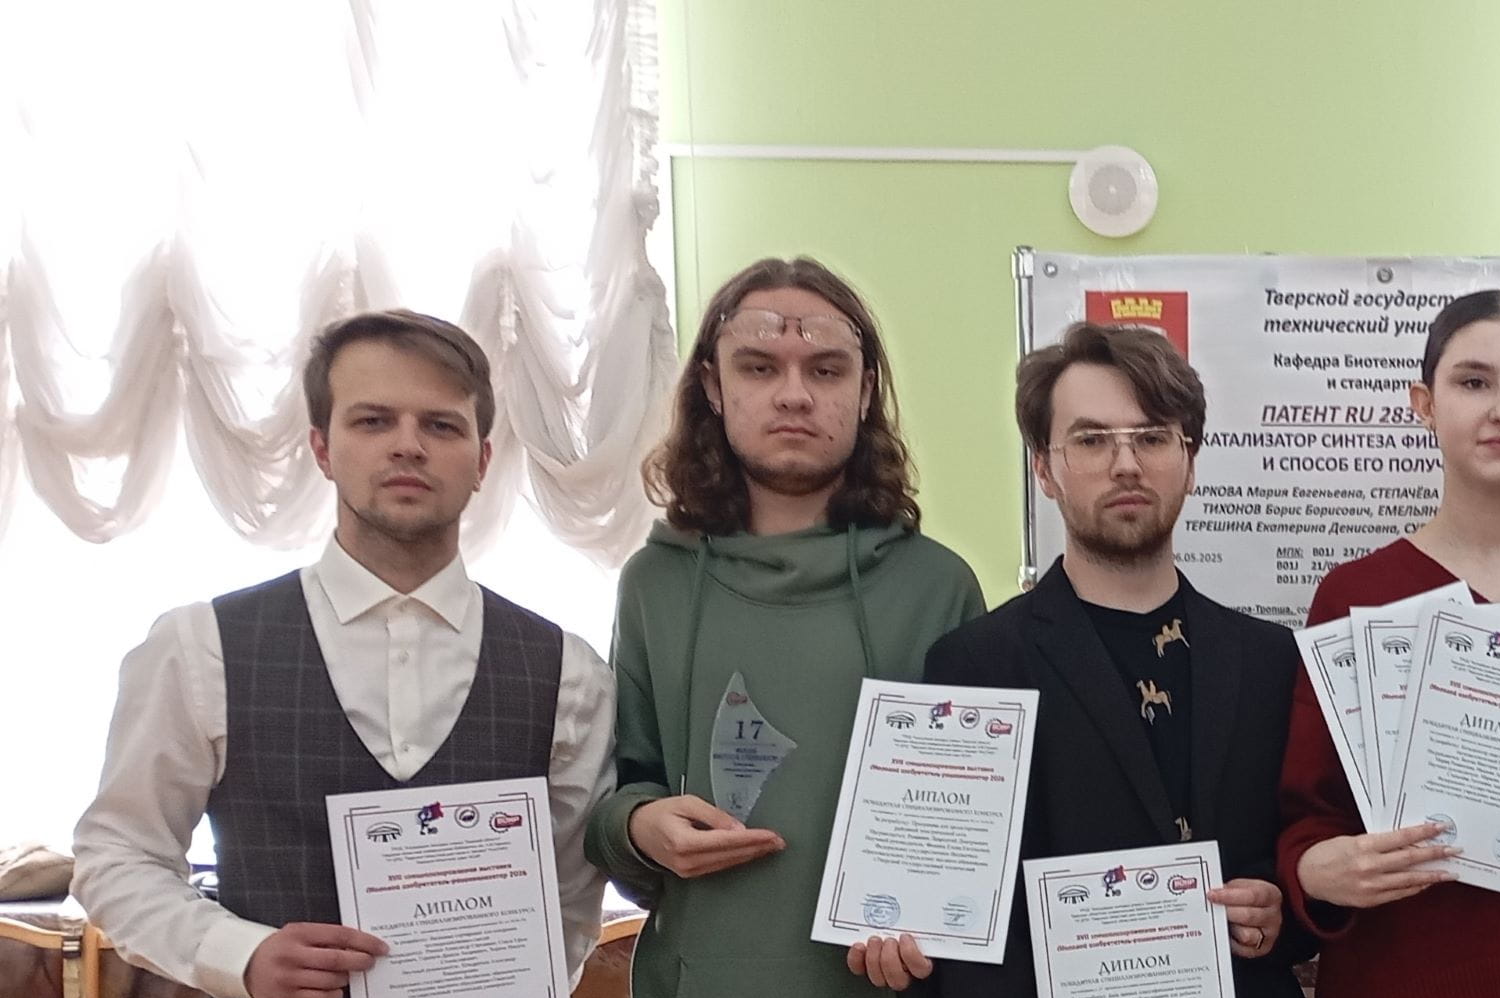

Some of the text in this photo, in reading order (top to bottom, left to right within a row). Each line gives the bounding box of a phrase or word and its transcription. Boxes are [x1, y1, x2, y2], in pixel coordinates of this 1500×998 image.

[1264, 288, 1349, 308] Тверской
[1263, 316, 1389, 335] технический
[1273, 353, 1340, 371] Кафедра
[1327, 379, 1337, 390] и
[1261, 404, 1423, 425] ПАТЕНТ RU 283
[1200, 432, 1317, 449] КАТАЛИЗАТОР
[1321, 432, 1397, 449] СИНТЕЗА
[1262, 456, 1275, 472] И
[1279, 456, 1349, 473] СПОСОБ
[1354, 457, 1385, 473] ЕГО
[1188, 485, 1440, 500] АРКОВА Мария Евгеньевна, СТЕПАЧЁВА
[1202, 503, 1262, 516] ТИХОНОВ
[1265, 503, 1302, 518] Борис
[1304, 503, 1374, 518] Борисович,
[1184, 520, 1253, 533] ТЕРЕШИНА
[1255, 520, 1326, 535] Екатерина
[1328, 521, 1400, 536] Денисовна,
[1276, 547, 1304, 559] МПК:
[735, 720, 764, 740] 17
[902, 788, 971, 806] ДИПЛОМ
[412, 895, 493, 919] ДИПЛОМ
[1098, 954, 1171, 976] ДИПЛОМ
